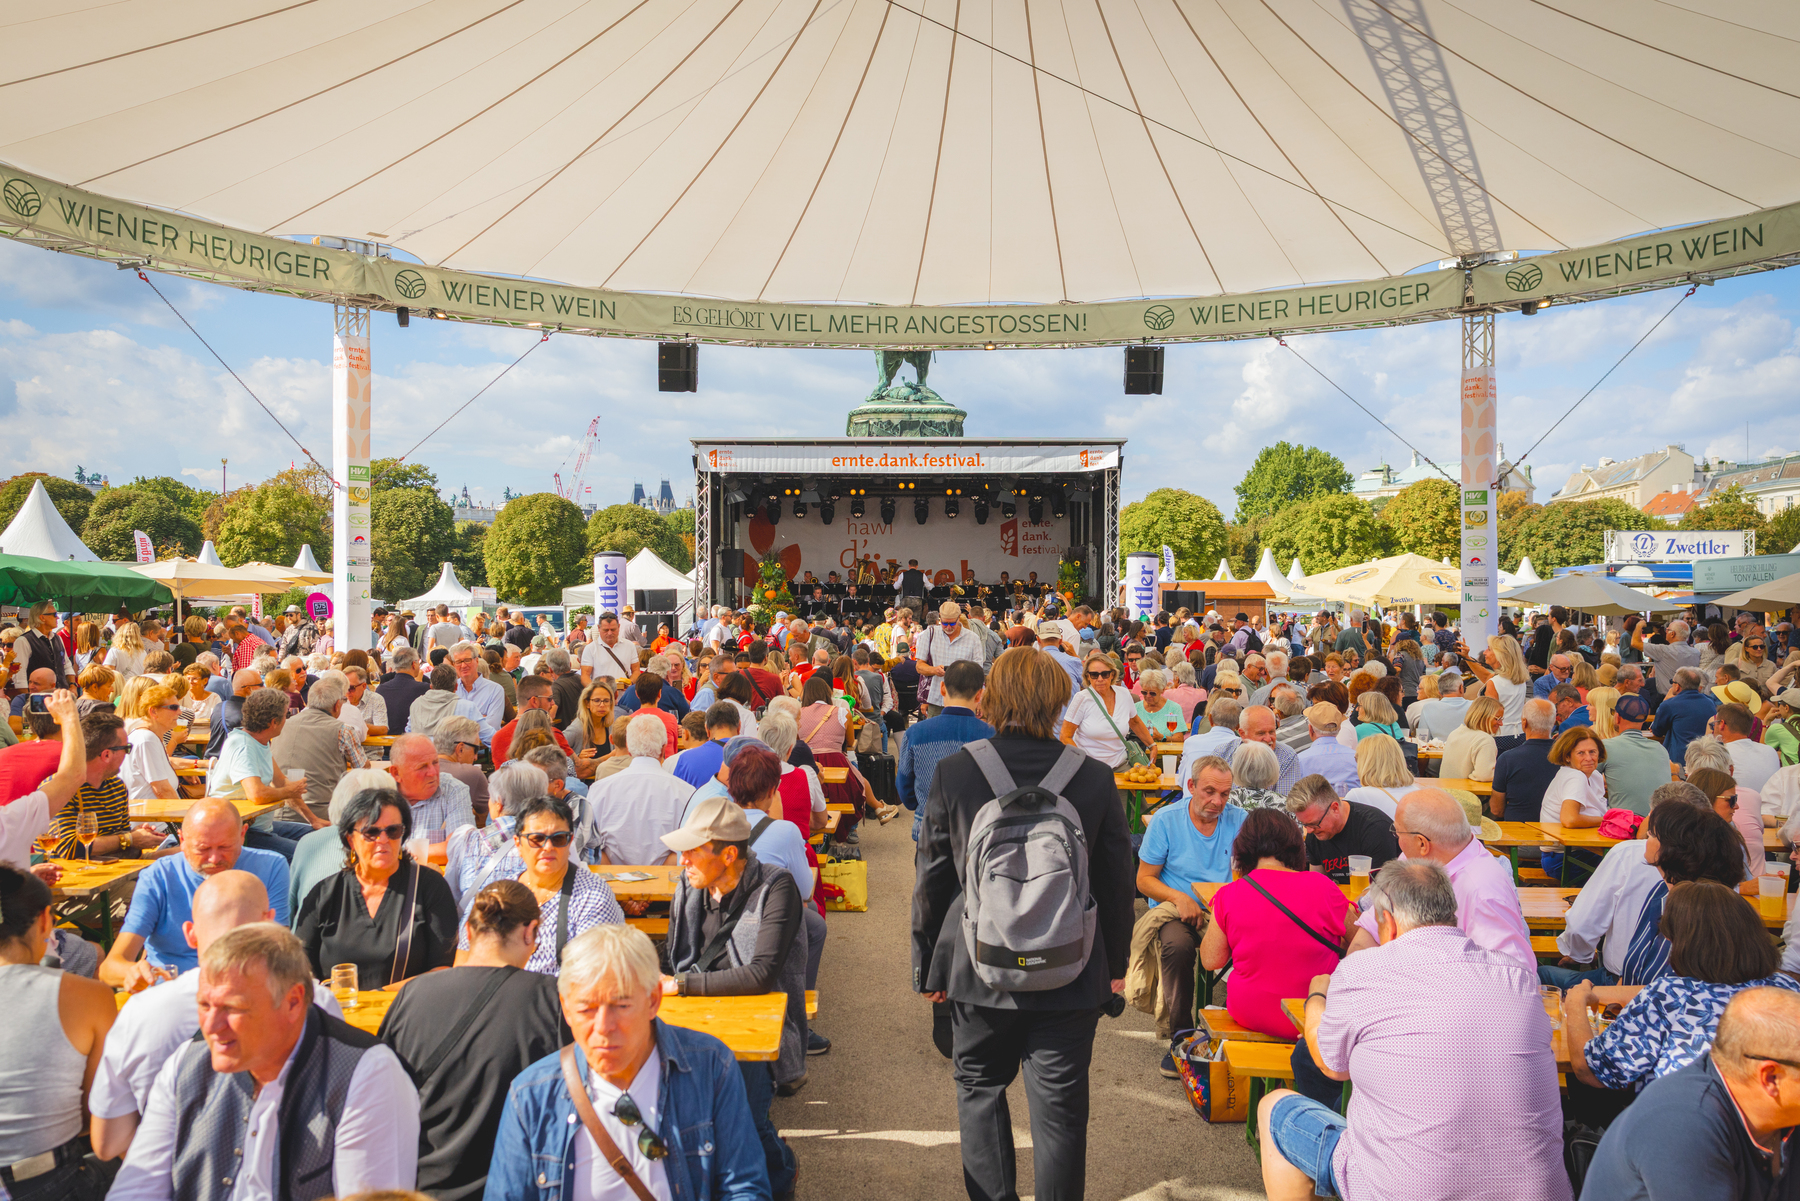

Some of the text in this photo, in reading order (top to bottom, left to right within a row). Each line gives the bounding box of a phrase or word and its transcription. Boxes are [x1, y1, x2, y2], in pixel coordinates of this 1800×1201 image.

[58, 197, 330, 281] WIENER HEURIGER
[1559, 223, 1763, 282] WIENER WEIN
[441, 280, 616, 320] WIENER WEIN
[1189, 282, 1431, 326] WIENER HEURIGER
[672, 305, 1088, 335] ES GEHÖRT VIEL MEHR ANGESTOSSEN!
[348, 353, 365, 362] dank.
[348, 362, 371, 371] festival.
[1464, 383, 1482, 391] dank.
[1464, 391, 1488, 399] festival.
[831, 452, 985, 467] ernte.dank.festival.
[1022, 531, 1052, 541] dank.
[1022, 544, 1063, 554] festival.
[1665, 538, 1730, 555] Zwettler
[1734, 573, 1774, 582] TONY ALLEN
[1465, 593, 1472, 601] lk
